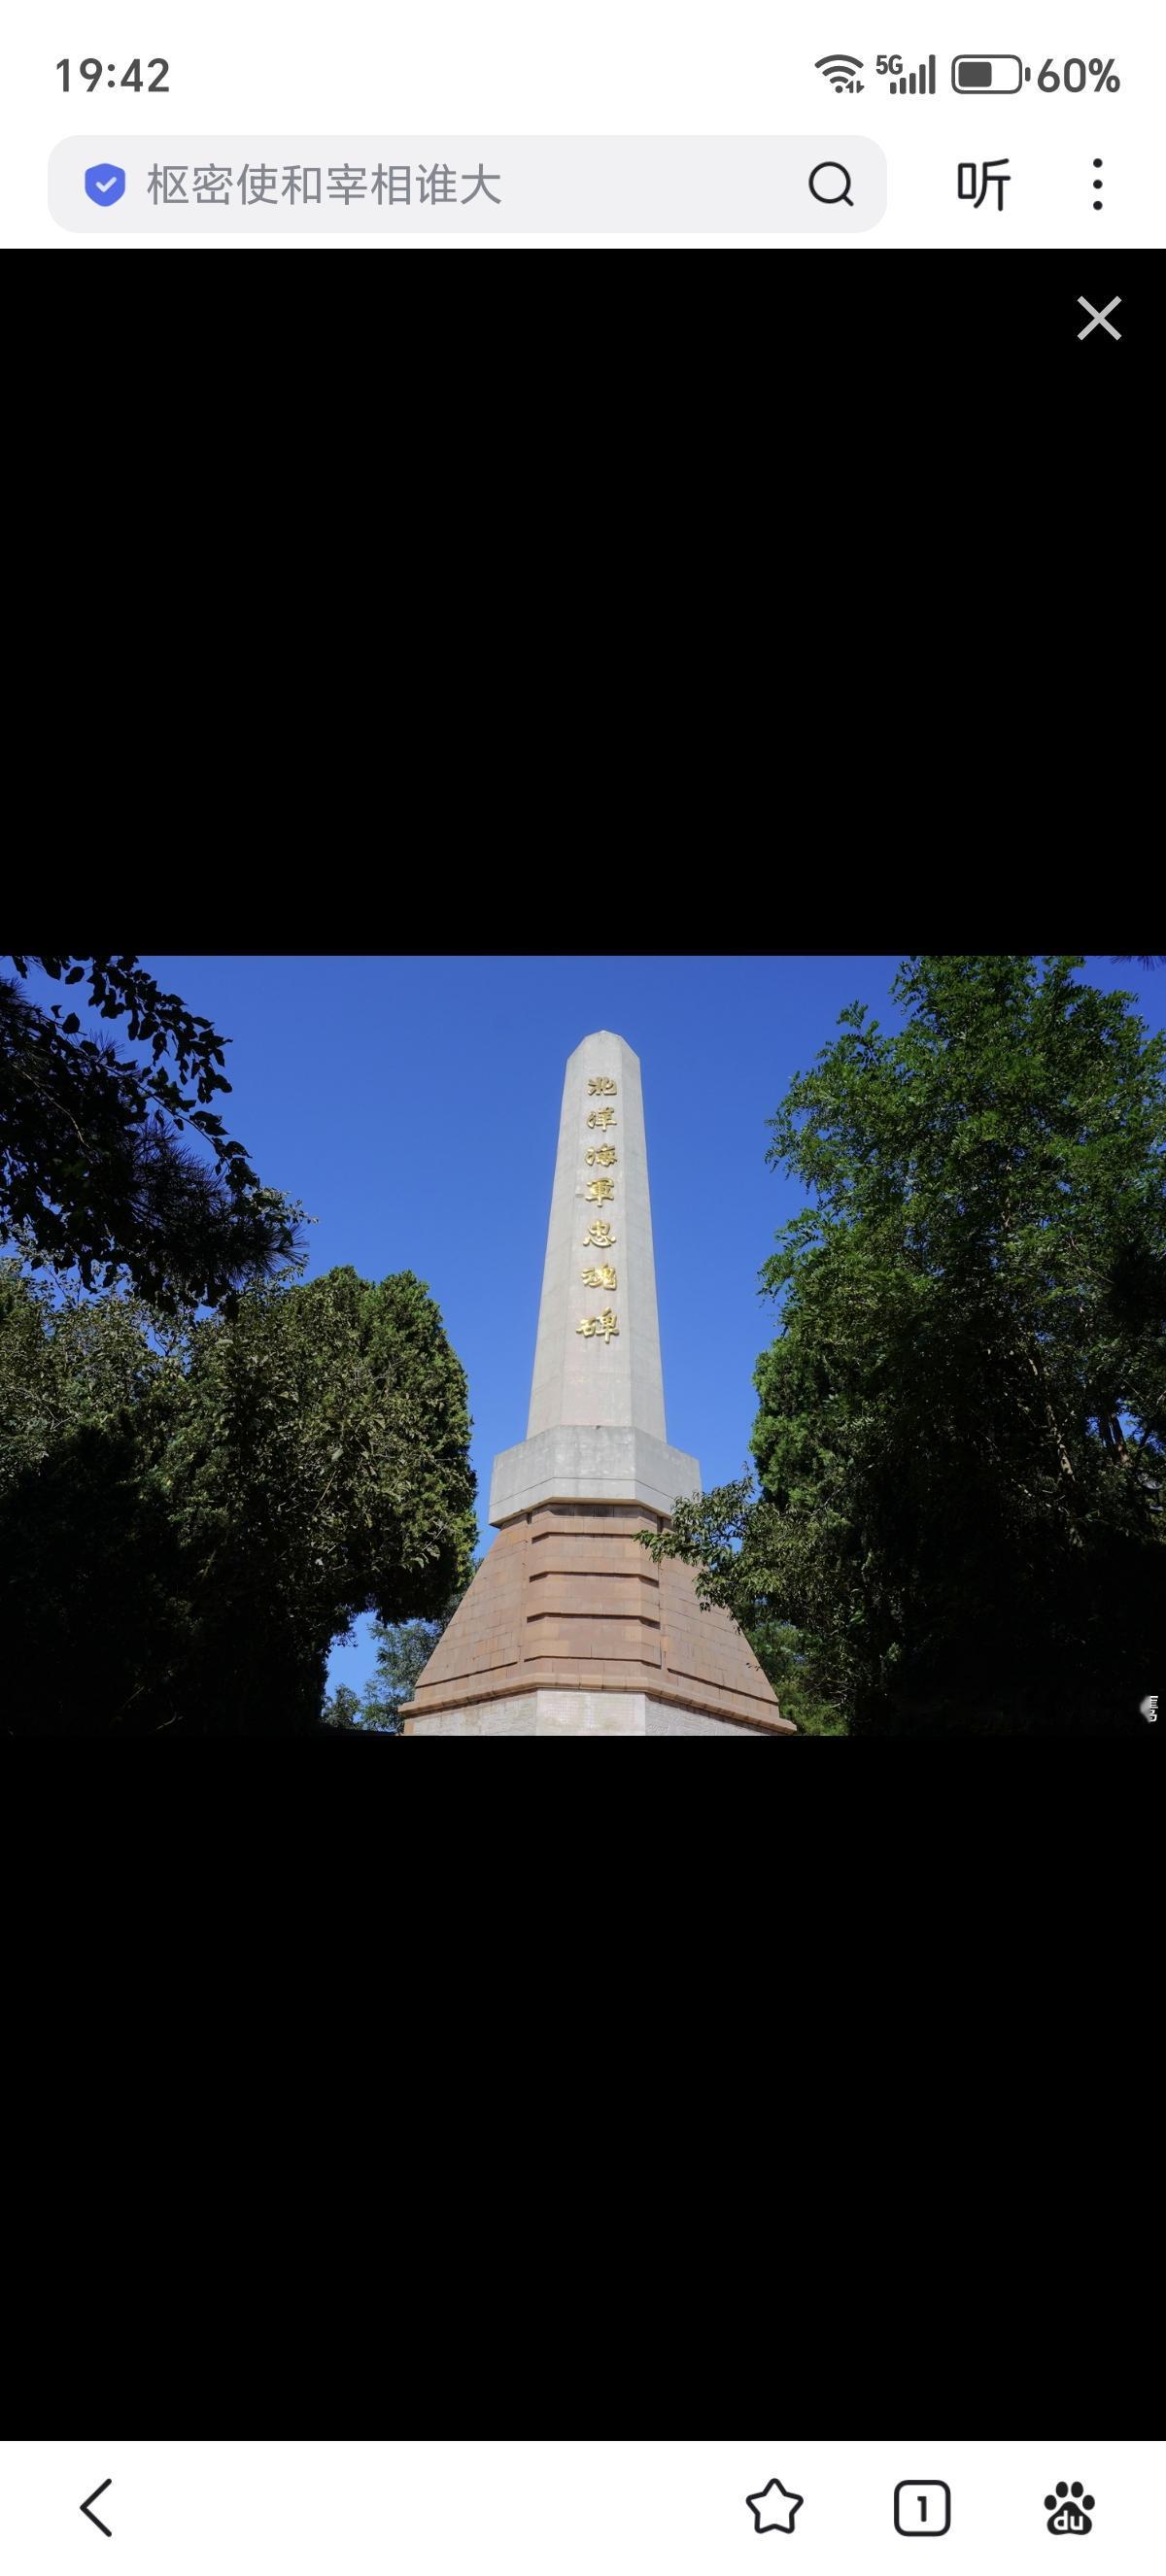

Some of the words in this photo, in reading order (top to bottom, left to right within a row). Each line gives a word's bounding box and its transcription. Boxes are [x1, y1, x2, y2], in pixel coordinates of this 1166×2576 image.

[56, 58, 169, 92] 19:42
[875, 54, 904, 75] 5G
[1037, 58, 1120, 92] 60%
[147, 163, 502, 206] 枢密使和宰相谁大
[957, 158, 1011, 212] 听
[917, 2496, 928, 2522] 1
[1052, 2510, 1084, 2531] du
